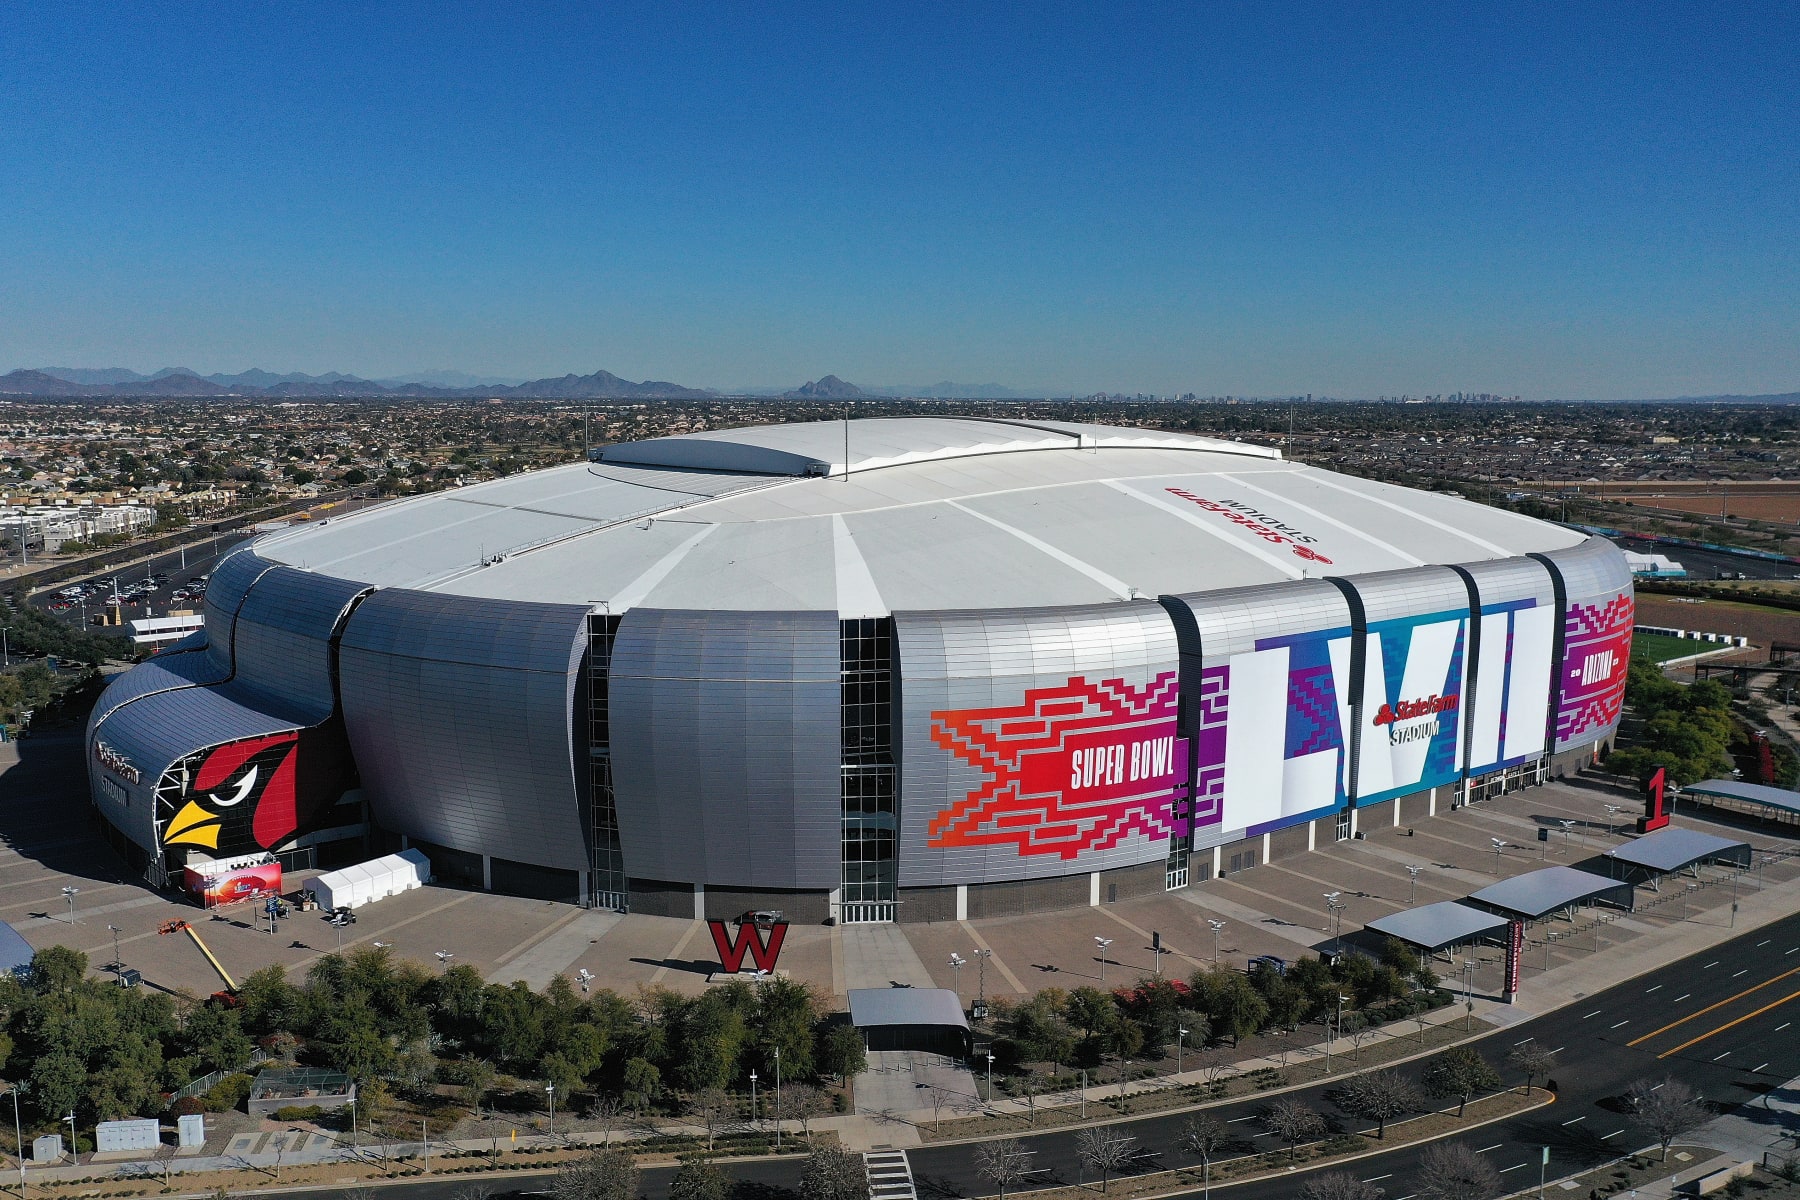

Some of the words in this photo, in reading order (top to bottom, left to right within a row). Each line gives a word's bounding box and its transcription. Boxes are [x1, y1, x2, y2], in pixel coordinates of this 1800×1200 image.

[1219, 499, 1318, 543] STADIUM
[1570, 669, 1581, 678] 20
[1581, 649, 1613, 686] ARIZONA
[1222, 604, 1555, 833] LVII
[1390, 720, 1440, 746] STADIUM
[1071, 744, 1125, 790] SUPER
[1129, 736, 1174, 782] BOWL
[1643, 766, 1669, 832] 1
[707, 920, 790, 975] W
